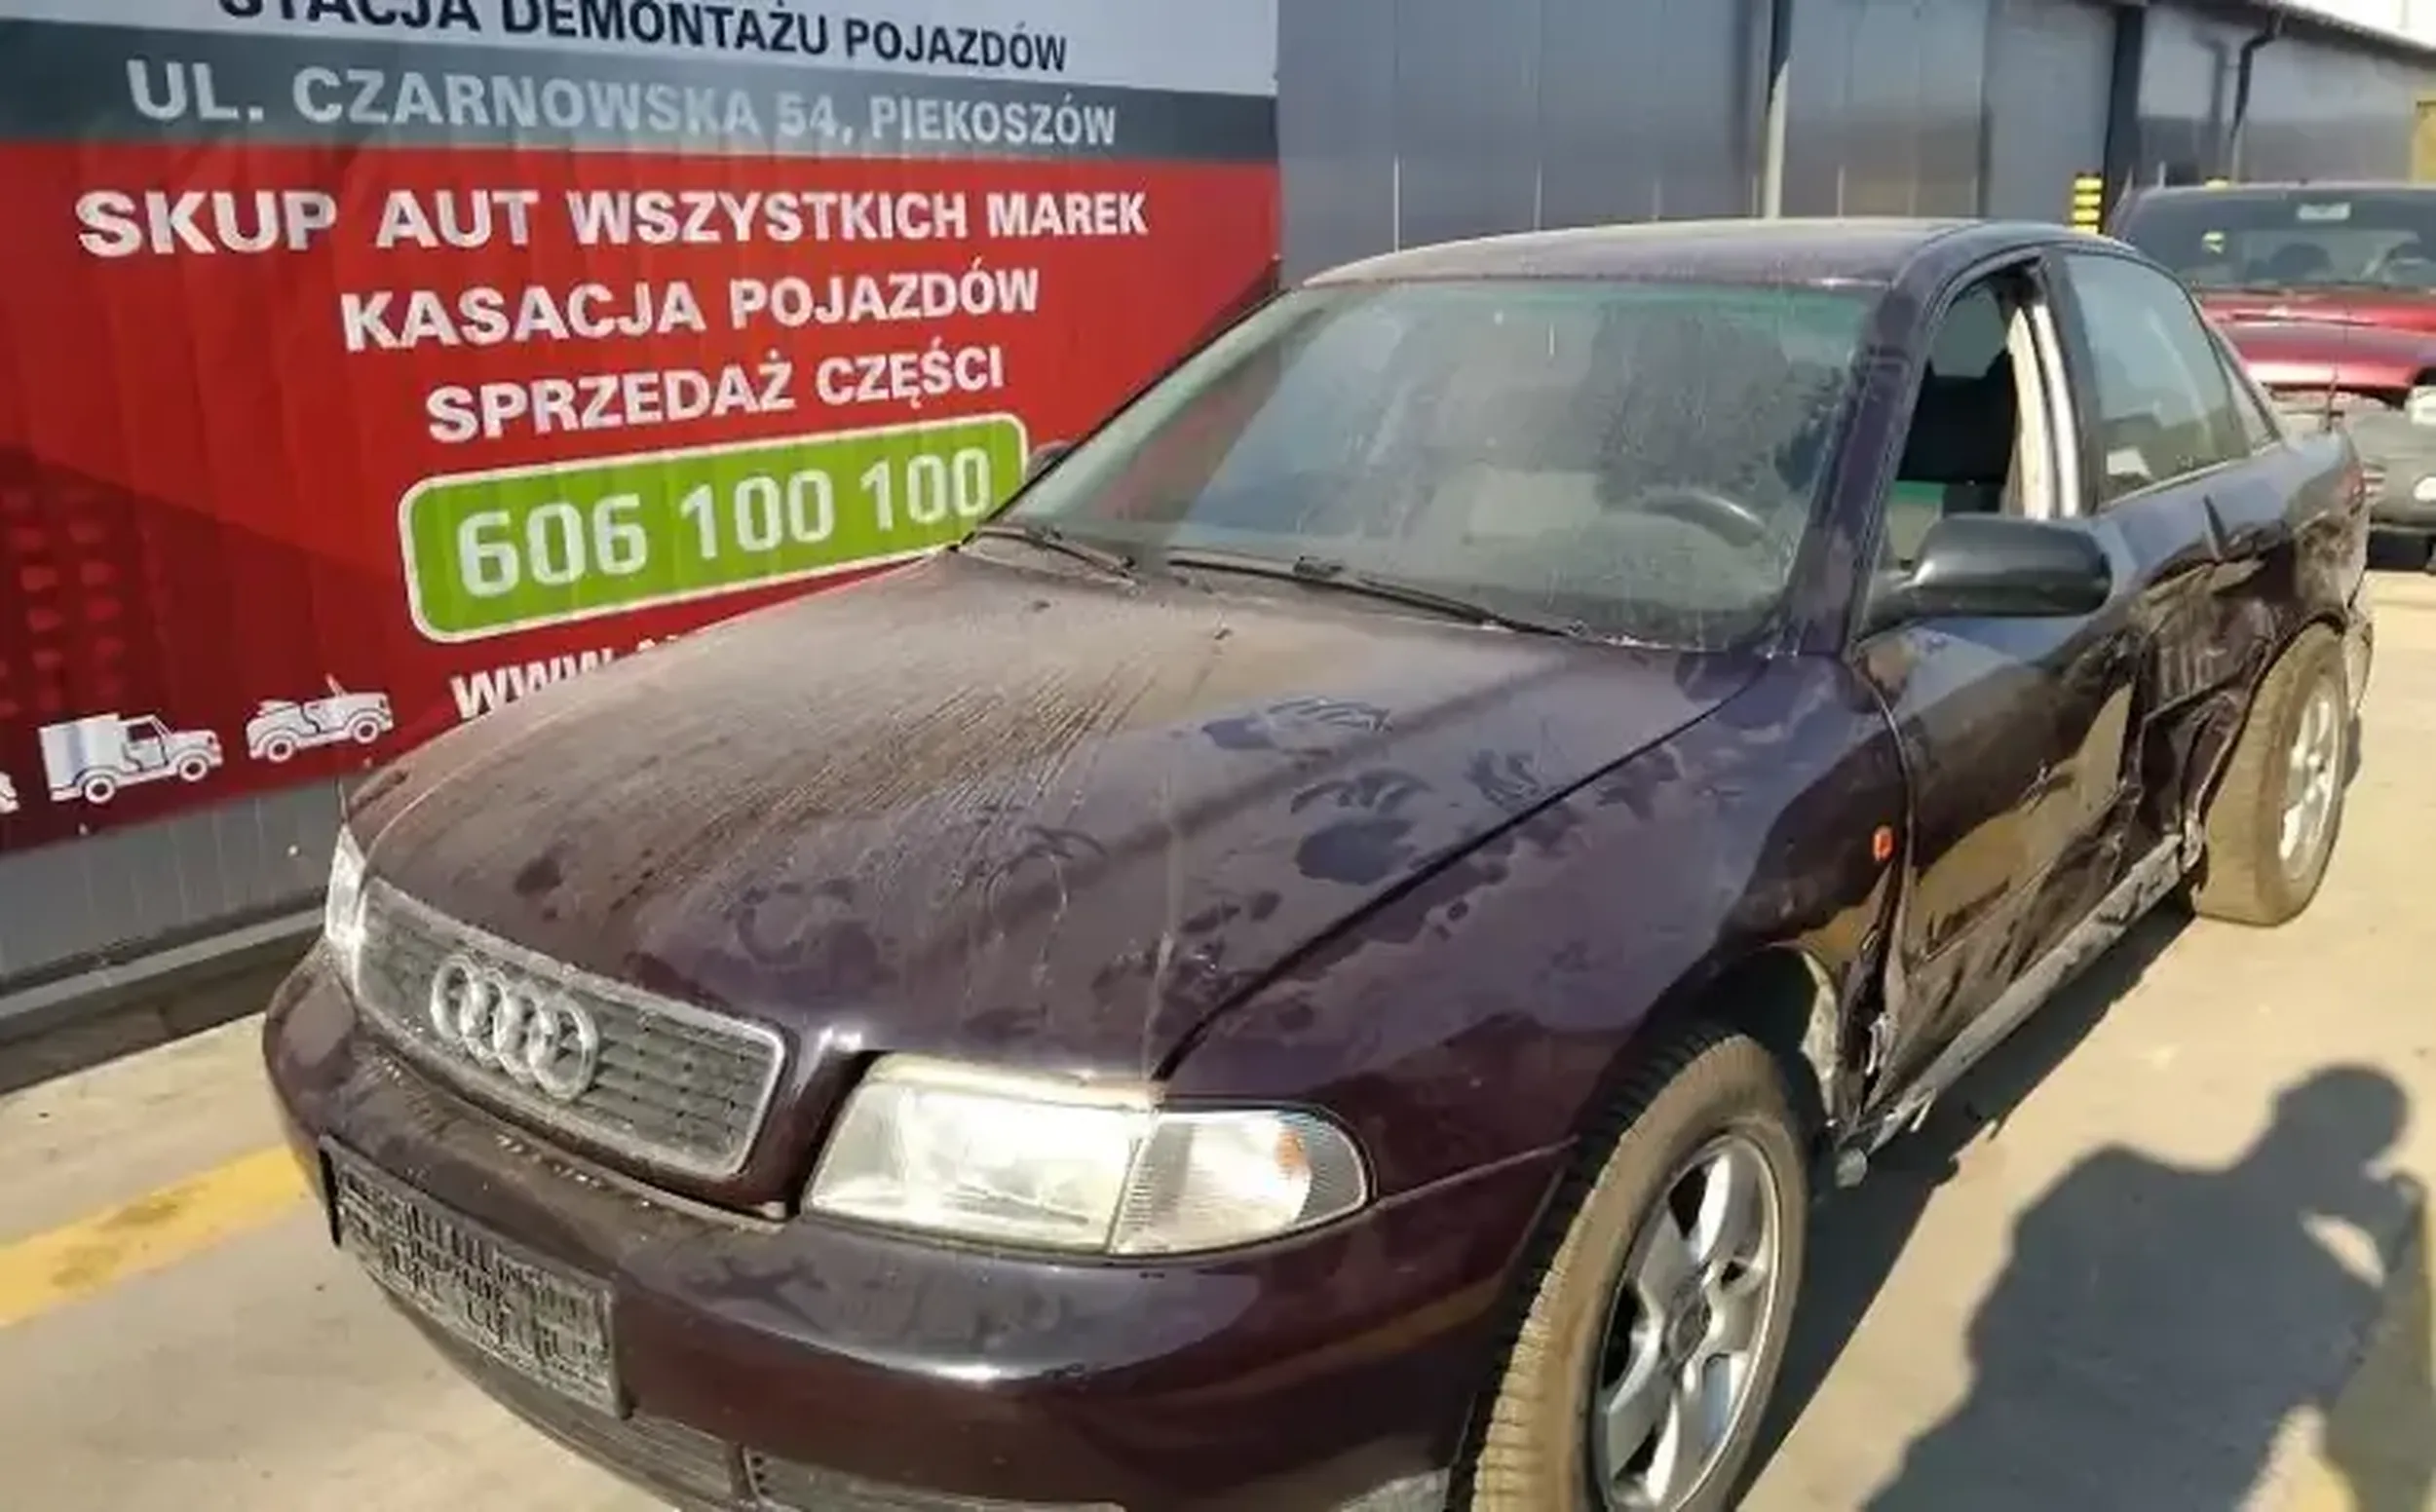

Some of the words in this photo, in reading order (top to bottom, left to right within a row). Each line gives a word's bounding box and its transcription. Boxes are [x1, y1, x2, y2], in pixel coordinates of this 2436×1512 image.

[502, 0, 827, 55] DEMONTAŻU
[844, 18, 1068, 72] POJAZDÓW
[127, 59, 264, 121] UL.
[293, 65, 759, 136] CZARNOWSKA
[778, 91, 854, 146] 54,
[871, 93, 1117, 146] PIEKOSZÓW
[75, 191, 337, 257] SKUP
[375, 190, 539, 248] AUT
[564, 191, 968, 246] WSZYSTKICH
[987, 193, 1148, 236] MAREK
[340, 281, 707, 353] KASACJA
[729, 258, 1039, 328] POJAZDÓW
[426, 350, 795, 443] SPRZEDAŻ
[817, 337, 1004, 409] CZĘŚCI
[456, 495, 648, 597] 606
[681, 468, 834, 559] 100
[859, 447, 991, 531] 100
